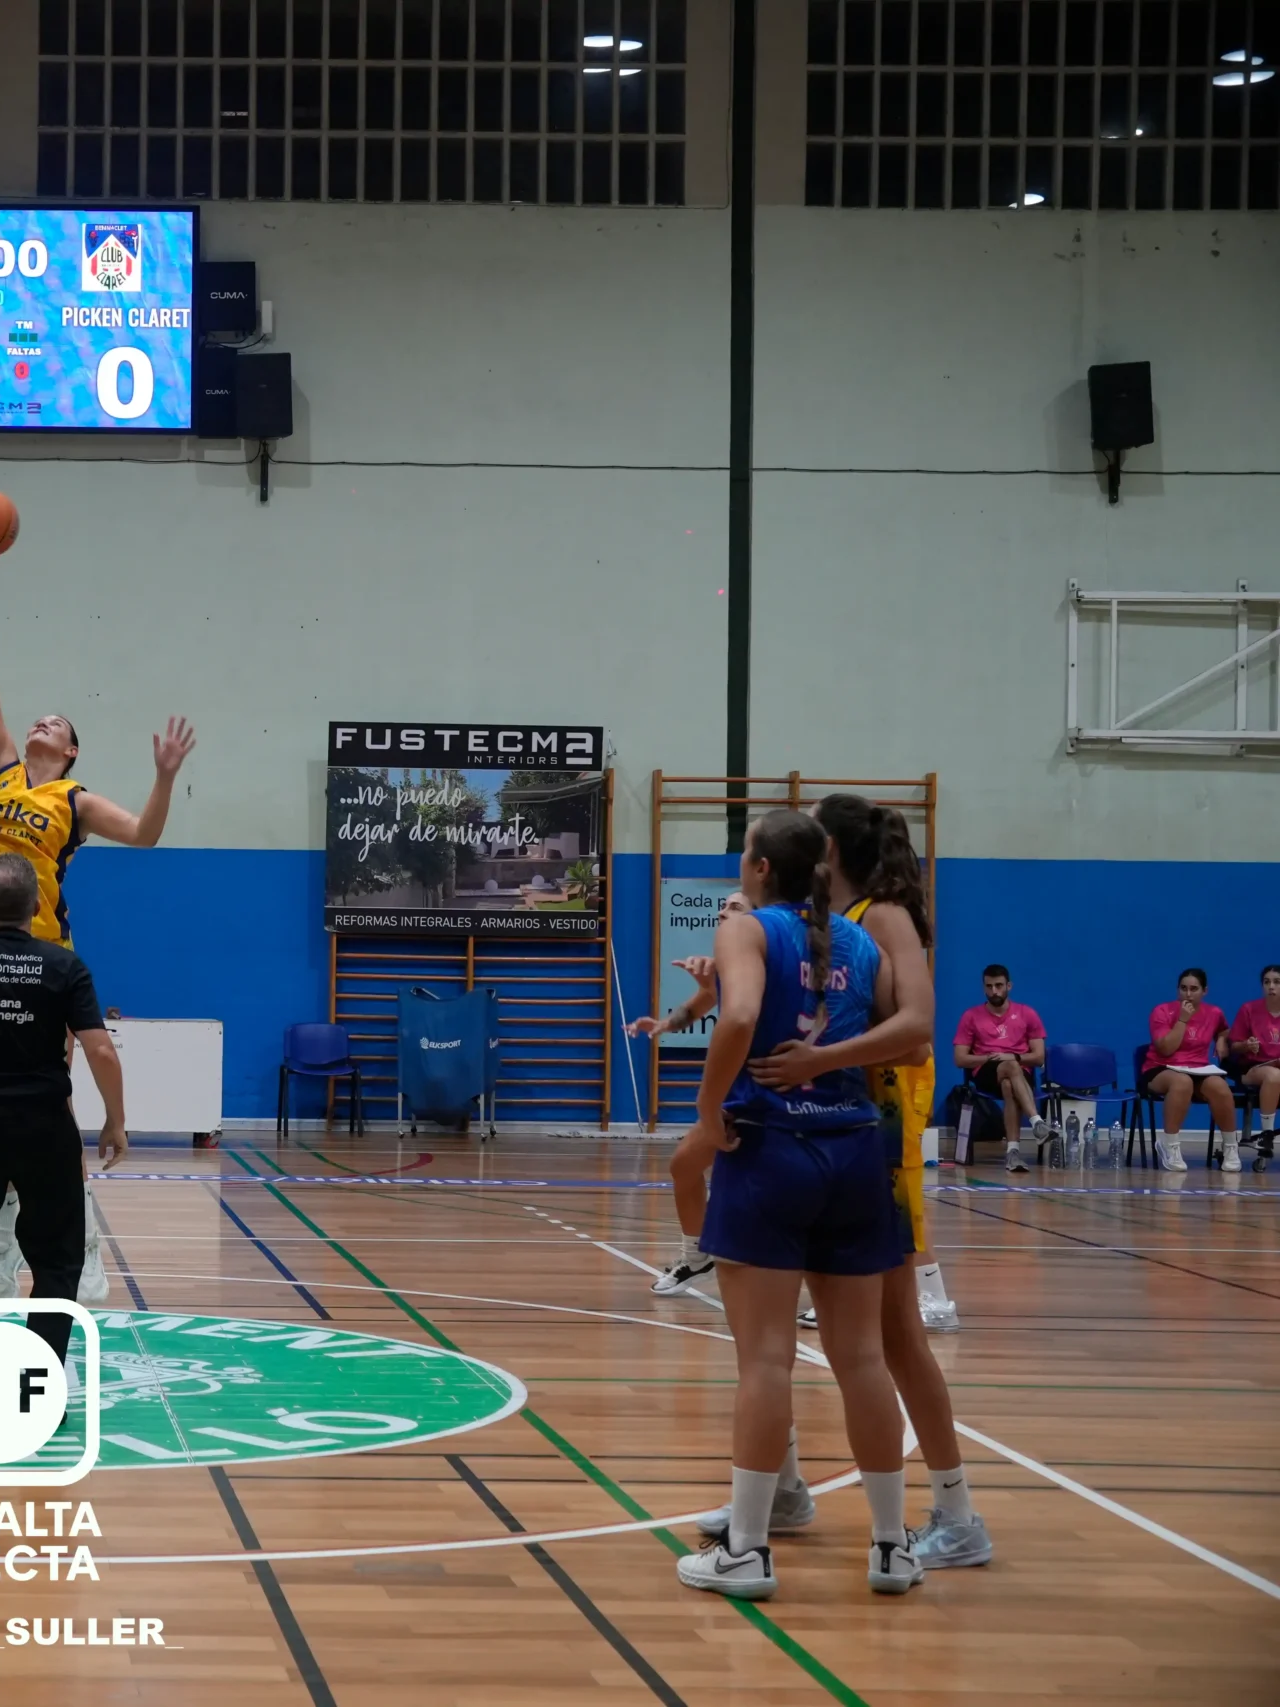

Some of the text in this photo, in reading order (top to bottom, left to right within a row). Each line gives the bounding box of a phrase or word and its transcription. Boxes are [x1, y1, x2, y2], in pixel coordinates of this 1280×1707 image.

[100, 246, 124, 263] CLUB
[96, 271, 127, 290] CLARET
[15, 320, 33, 329] TM
[61, 307, 191, 328] PICKEN CLARET
[6, 347, 42, 355] FALTAS
[14, 361, 30, 380] 0
[96, 346, 154, 419] 0
[467, 755, 558, 765] INTERIORS
[396, 776, 467, 820] puedo
[338, 812, 540, 862] dejar de mirarte.
[670, 893, 713, 908] Cada
[335, 915, 598, 930] REFORMAS INTEGRALES ARMARIOS VESTIDO
[15, 954, 43, 962] Médico
[10, 976, 19, 984] de
[20, 976, 41, 985] Colón
